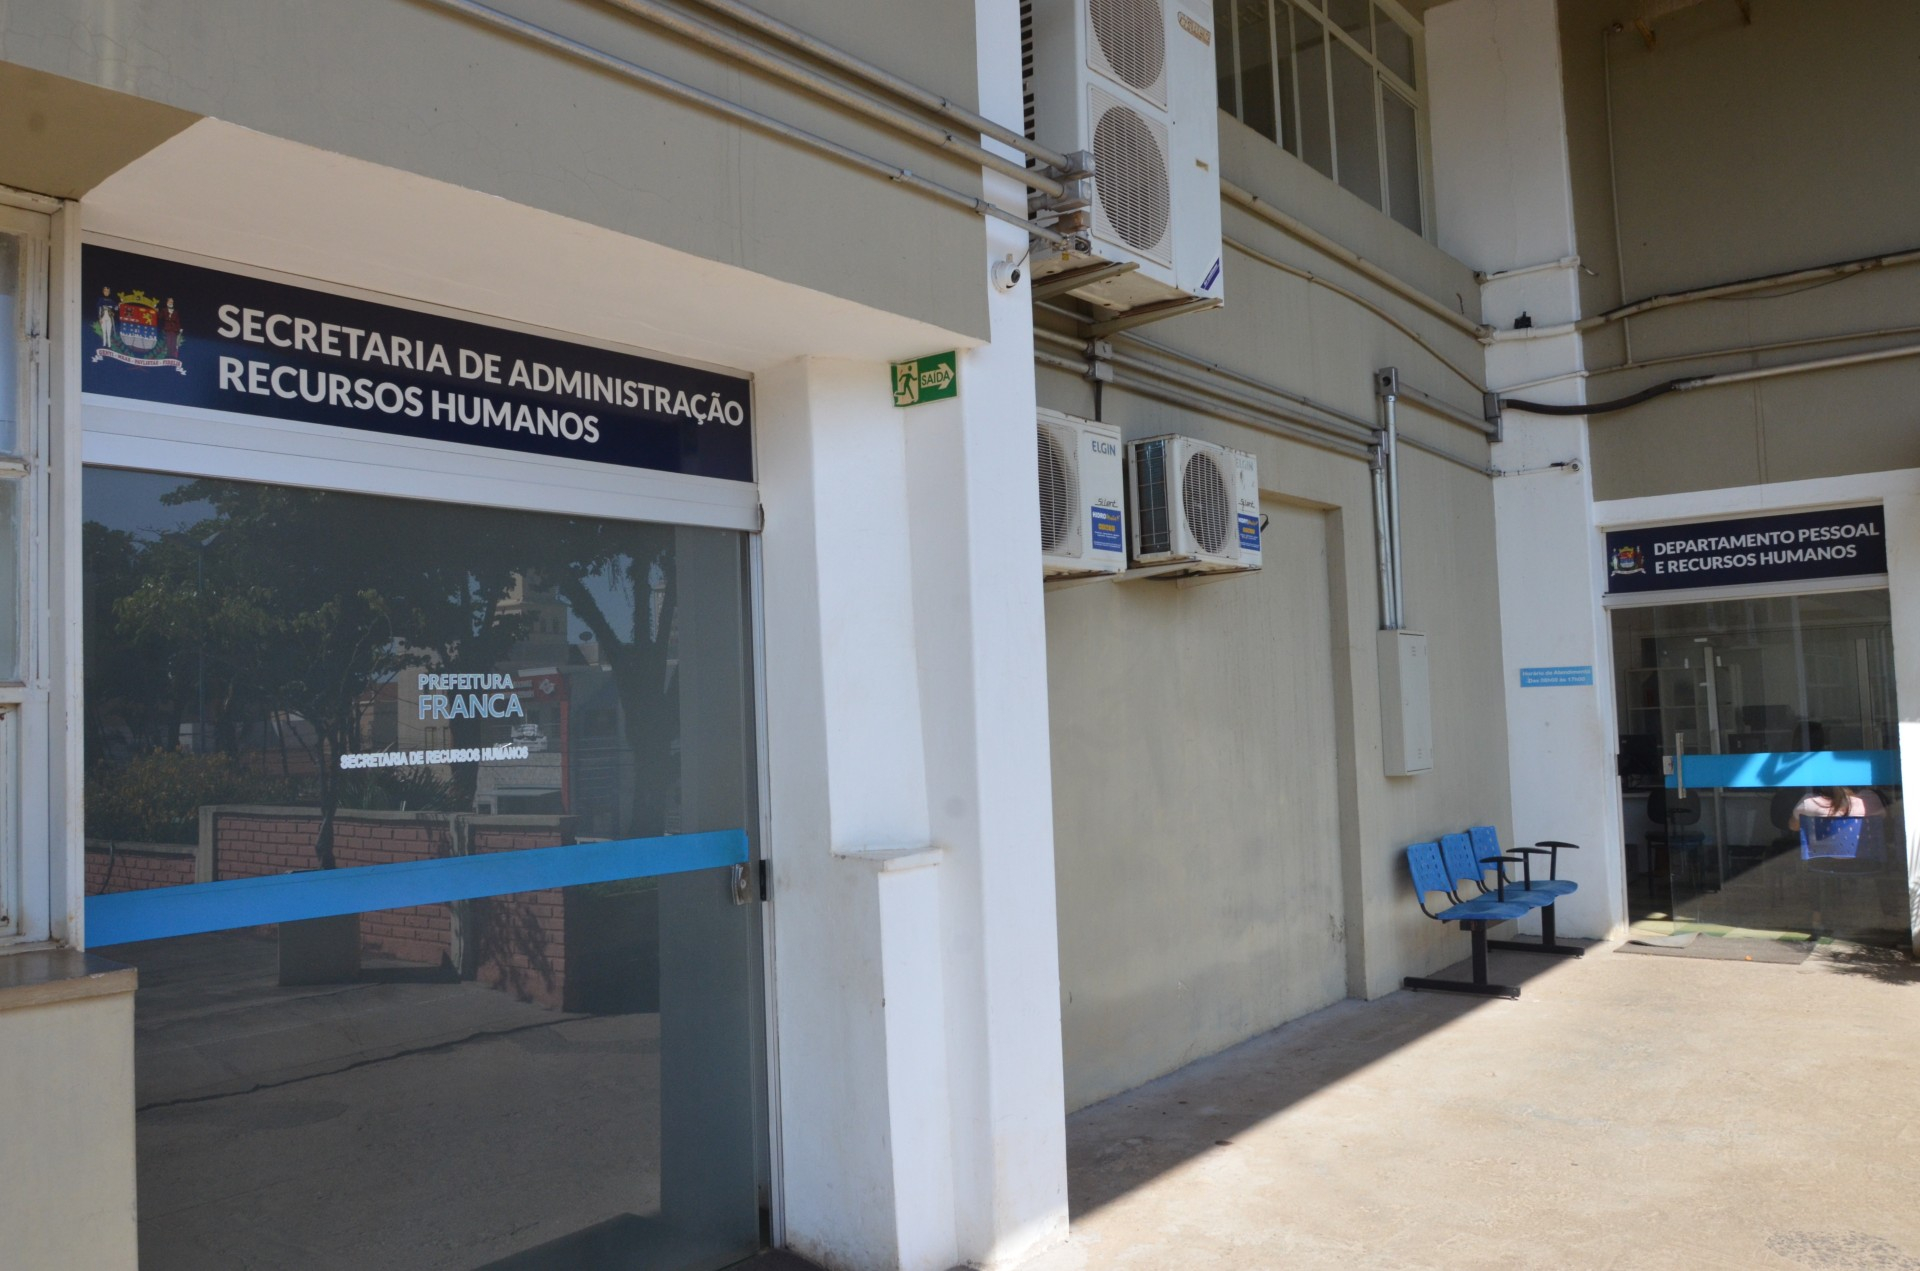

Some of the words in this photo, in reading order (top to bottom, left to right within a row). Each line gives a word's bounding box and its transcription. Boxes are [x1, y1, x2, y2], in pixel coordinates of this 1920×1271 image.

[217, 304, 452, 375] SECRETARIA
[459, 348, 501, 384] DE
[508, 359, 744, 426] ADMINISTRAÇÃO
[921, 370, 950, 386] SAÍDA
[219, 355, 424, 417] RECURSOS
[431, 390, 599, 443] HUMANOS
[1092, 440, 1116, 456] ELGIN
[1654, 530, 1795, 556] DEPARTAMENTO
[1798, 522, 1880, 543] PESSOAL
[1655, 561, 1665, 574] E
[1668, 553, 1757, 574] RECURSOS
[1760, 544, 1857, 565] HUMANOS
[418, 673, 514, 690] PREFEITURA
[418, 693, 524, 720] FRANCA
[340, 752, 408, 770] SECRETARIA
[408, 751, 425, 766] DE
[425, 748, 480, 764] RECURSOS
[481, 746, 529, 762] HUMANOS
